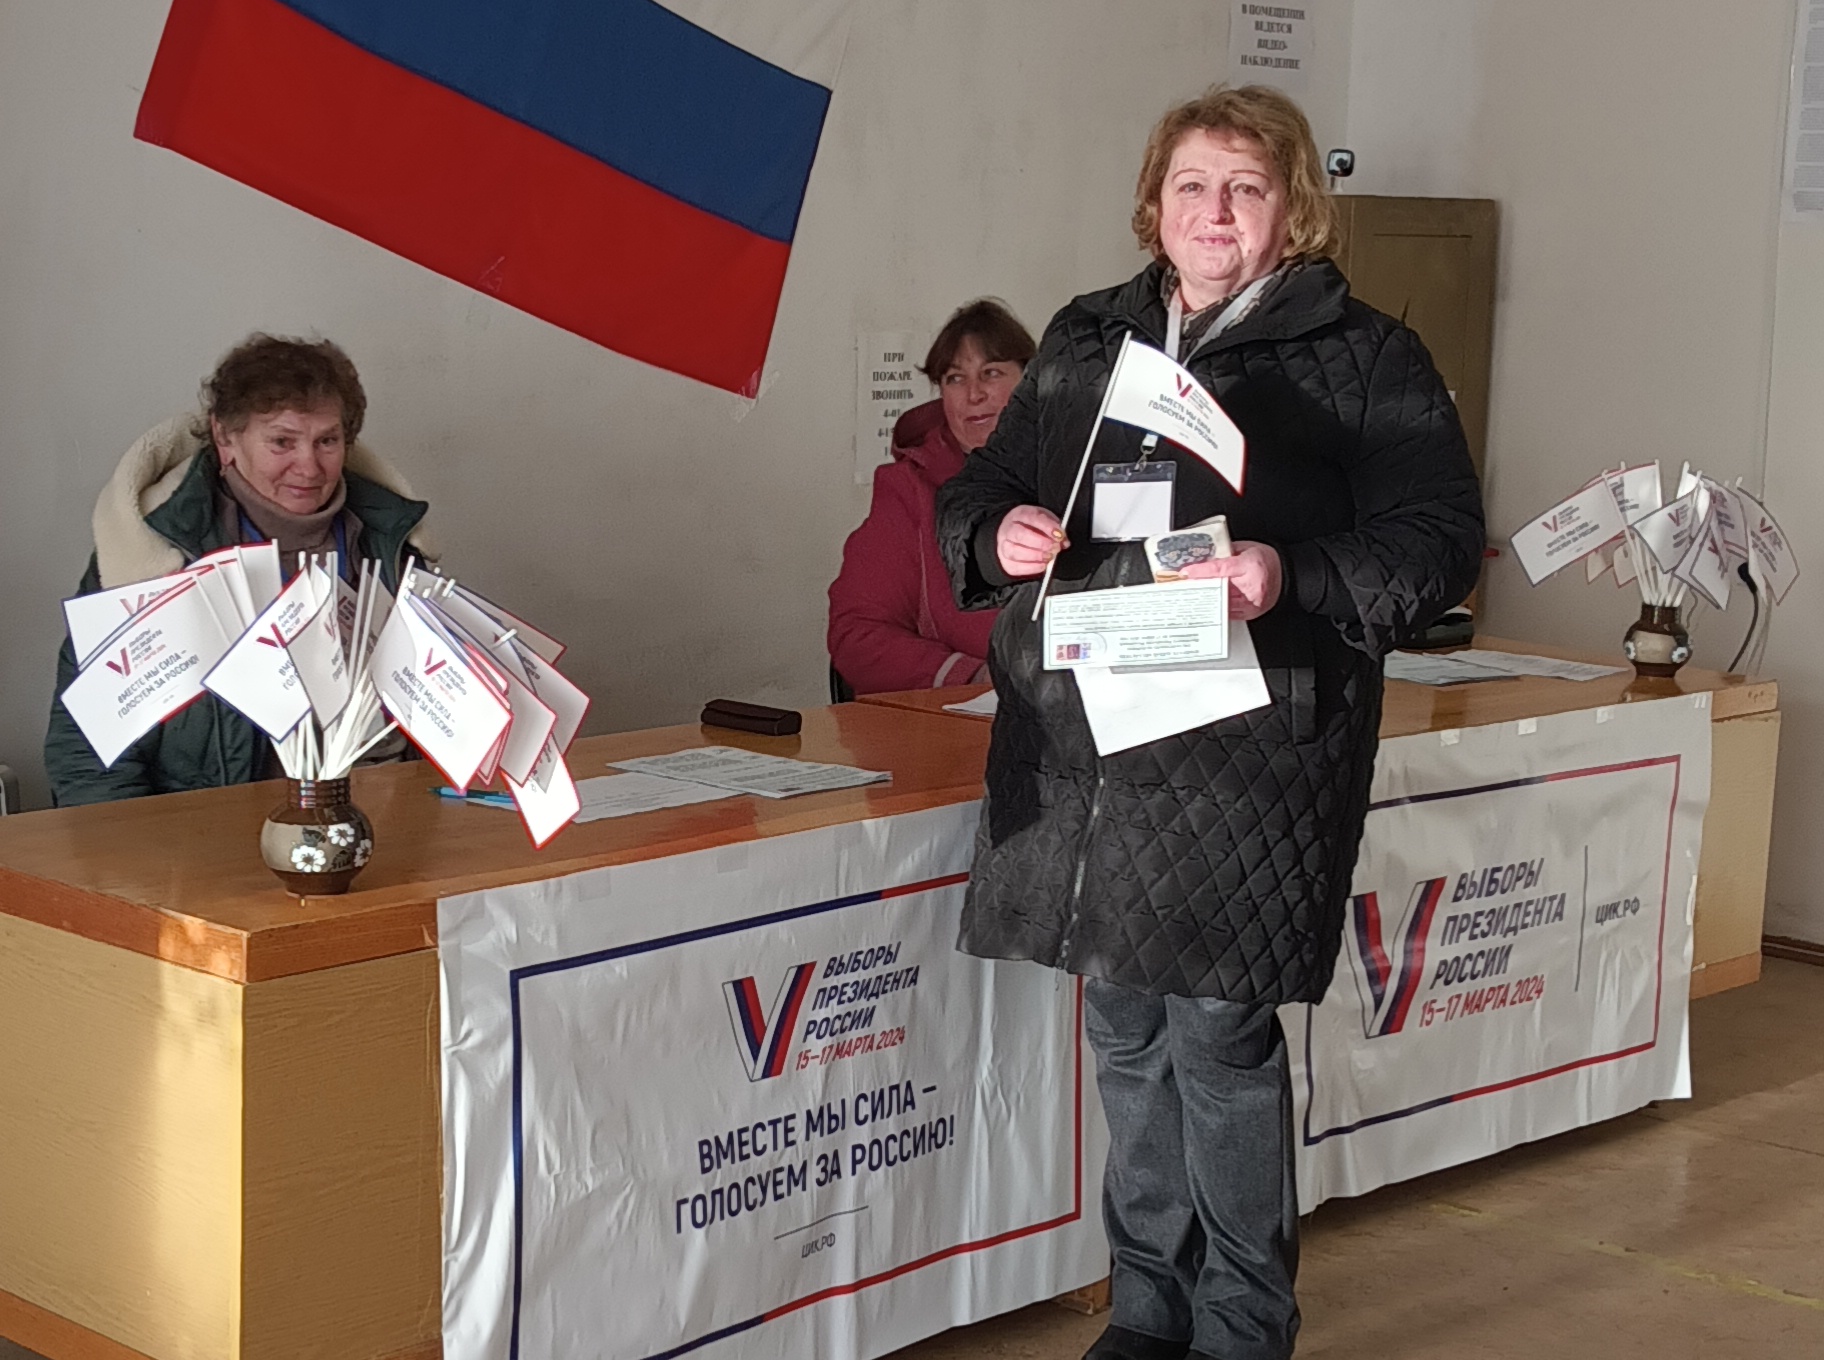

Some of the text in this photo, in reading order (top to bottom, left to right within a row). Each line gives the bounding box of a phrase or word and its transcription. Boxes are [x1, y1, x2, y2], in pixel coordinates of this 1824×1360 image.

[1241, 3, 1305, 20] В ПОМЕЩЕНИИ
[1254, 20, 1293, 34] ВЕДЕТСЯ
[1240, 54, 1301, 70] НАБЛЮДЕНИЕ
[872, 371, 912, 382] ПОЖАРЕ
[883, 352, 905, 363] ПРИ
[872, 389, 914, 401] ЗВОНИТЬ
[117, 676, 146, 704] ВМЕСТЕ
[144, 666, 160, 681] МЫ
[159, 652, 182, 670] СИЛА
[117, 684, 156, 719] ГОЛОСУЕМ
[154, 678, 166, 688] ЗА
[1451, 857, 1545, 903] ВЫБОРЫ
[1440, 892, 1566, 947] ПРЕЗИДЕНТА
[1595, 896, 1641, 926] ЦИК.РФ
[823, 941, 901, 979] ВЫБОРЫ
[1429, 943, 1514, 990] РОССИИ
[812, 965, 920, 1011] ПРЕЗИДЕНТА
[1460, 984, 1508, 1018] МАРТА
[1509, 973, 1545, 1006] 2024
[802, 1004, 876, 1044] РОССИИ
[832, 1032, 875, 1062] МАРТА
[876, 1025, 906, 1051] 2024
[698, 1113, 797, 1175] ВМЕСТЕ
[804, 1098, 847, 1142] МЫ
[854, 1080, 916, 1127] СИЛА
[675, 1114, 955, 1235] ГОЛОСУЕМ ЗА РОССИЮ!
[801, 1232, 836, 1259] ЦИК.РФ
